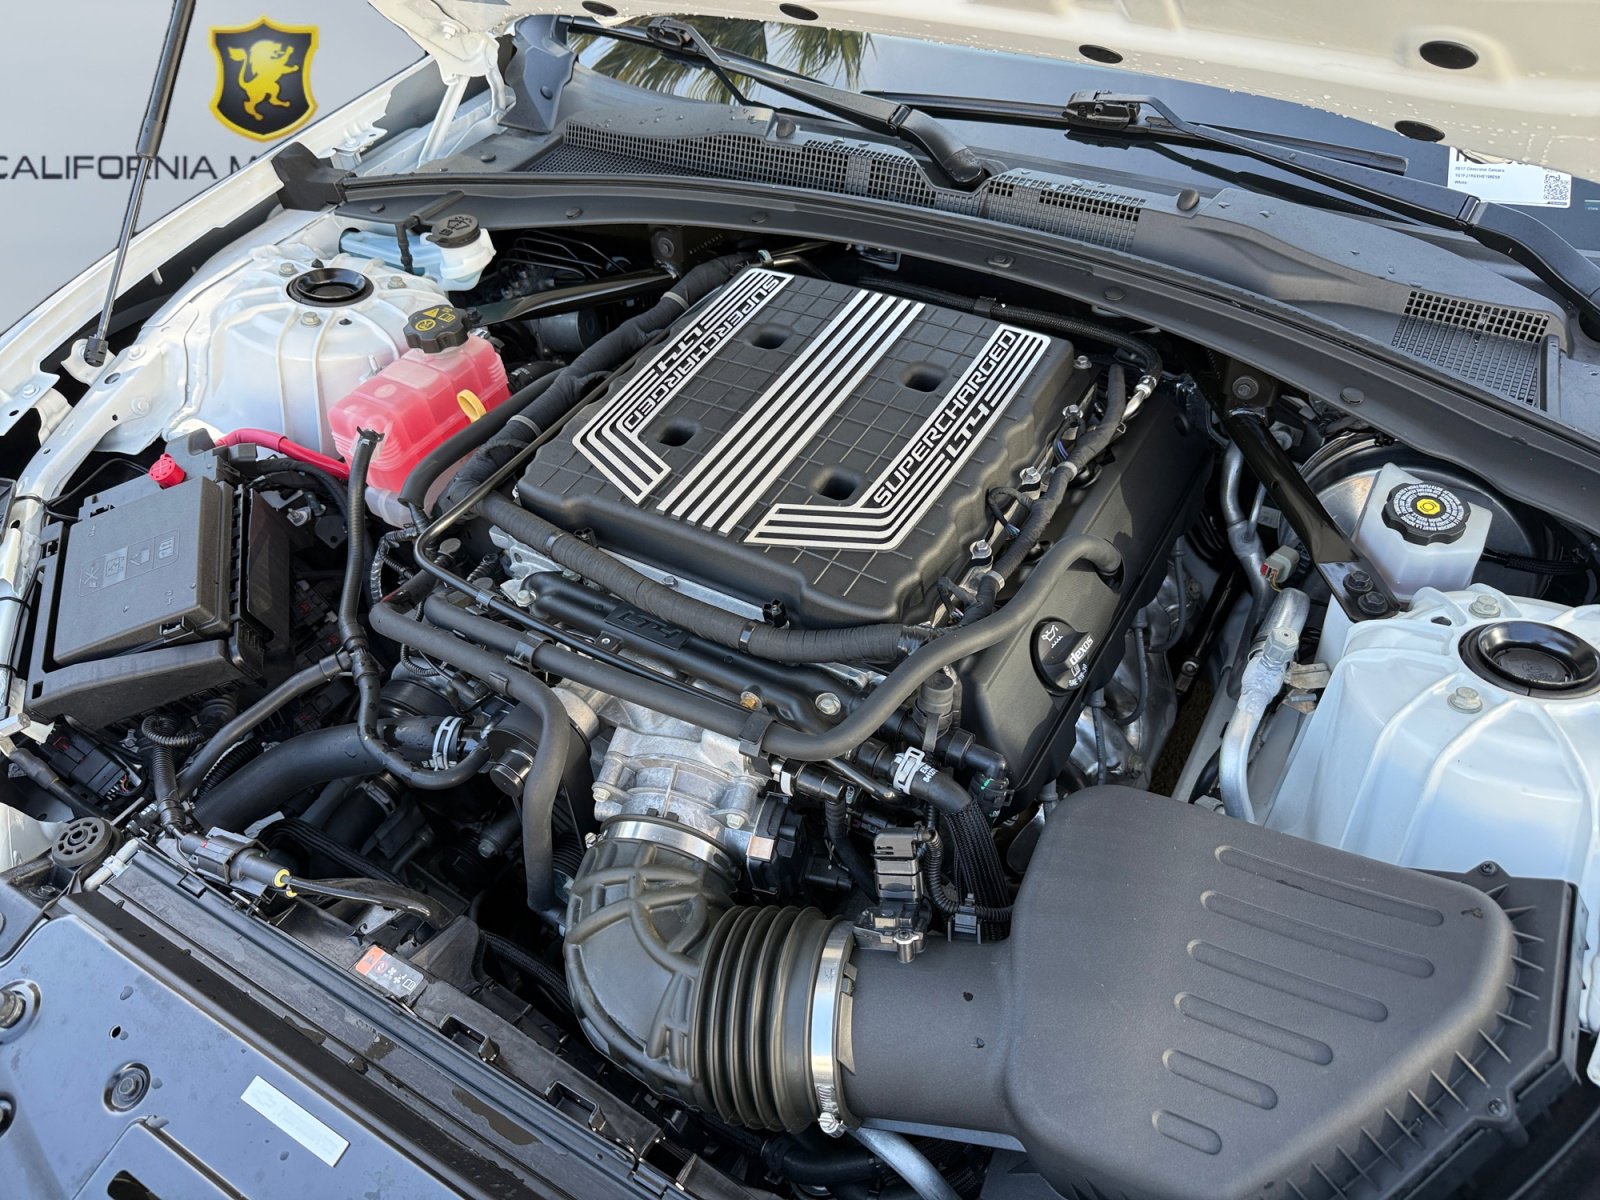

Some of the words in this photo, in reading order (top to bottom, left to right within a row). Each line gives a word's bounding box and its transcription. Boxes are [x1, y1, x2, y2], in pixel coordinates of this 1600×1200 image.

[624, 275, 780, 430] SUPERCHARGED
[657, 326, 703, 372] LT4
[873, 330, 1017, 507] SUPERCHARGED
[946, 403, 991, 459] LT4
[1070, 635, 1093, 665] dexos
